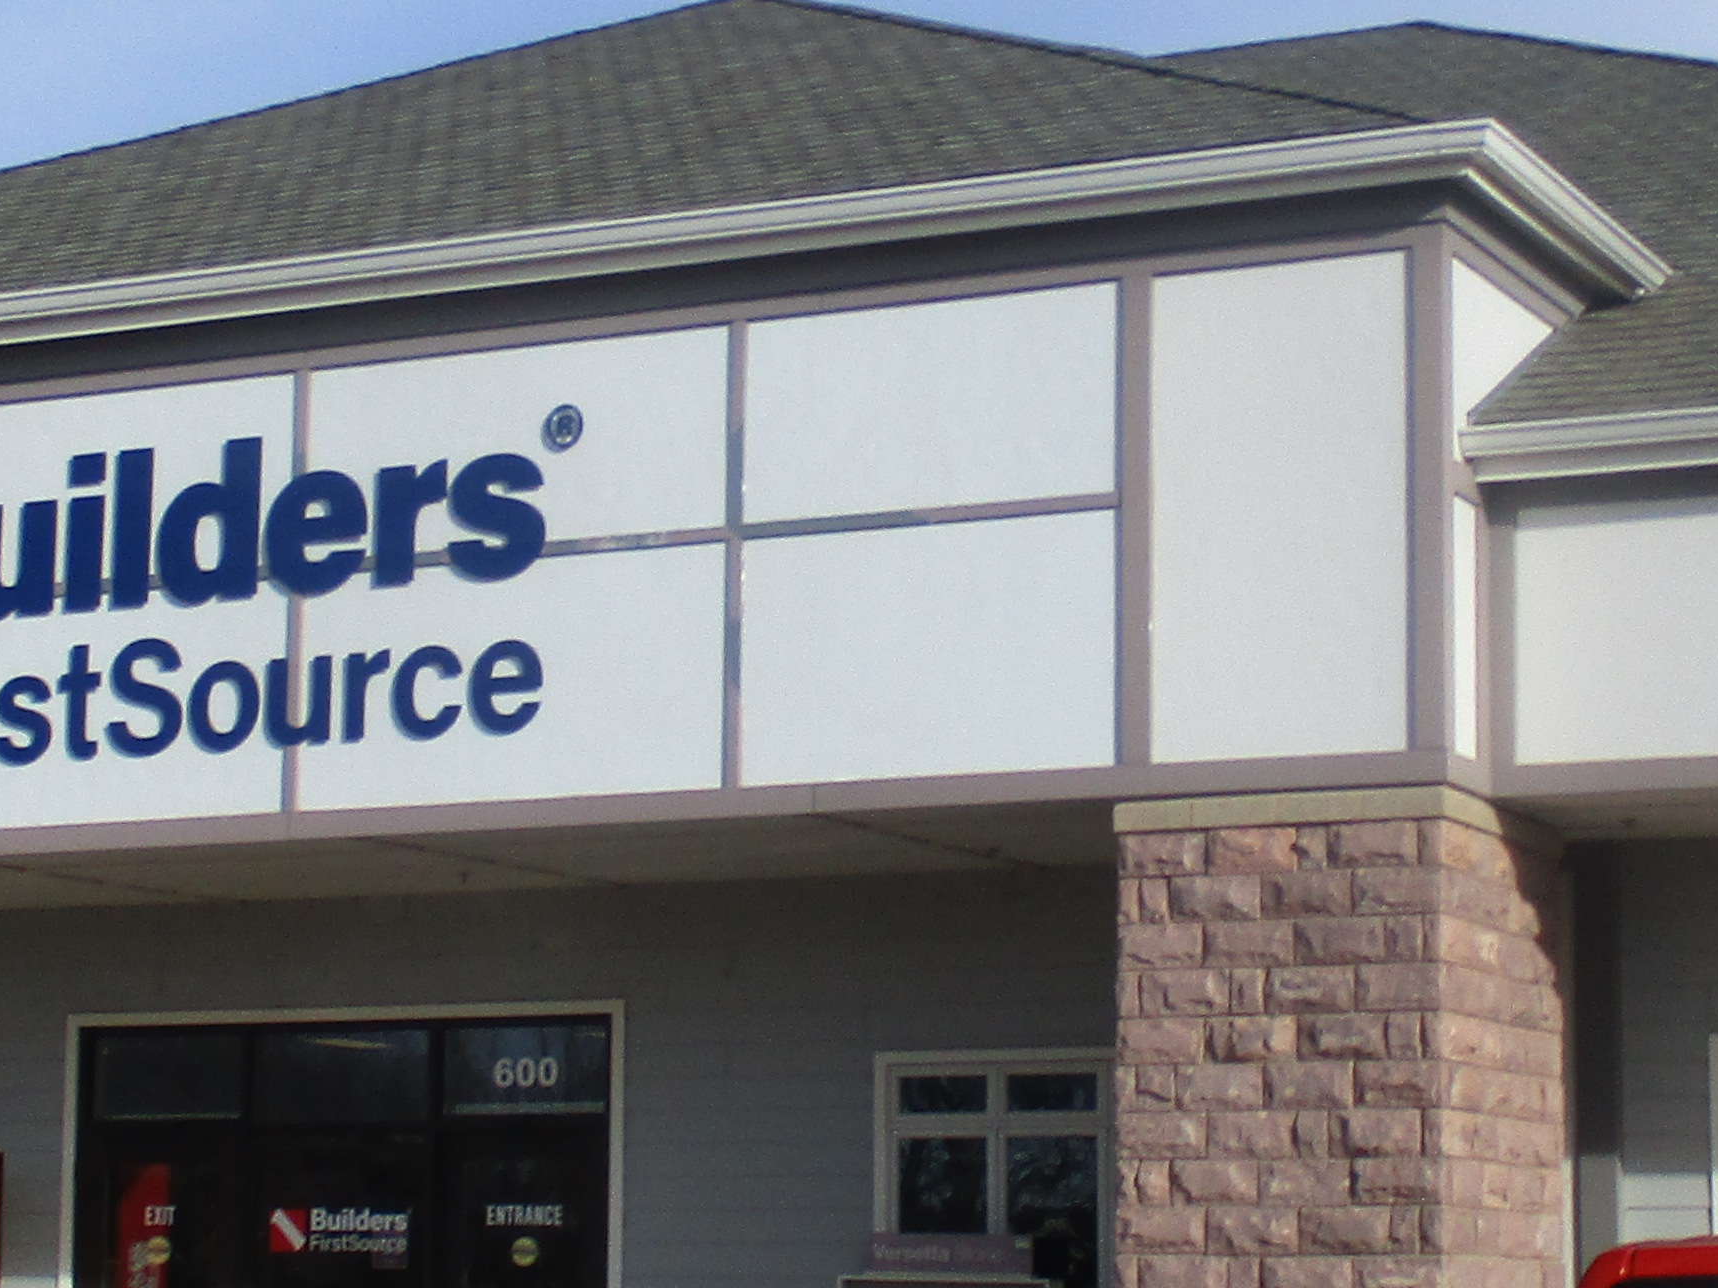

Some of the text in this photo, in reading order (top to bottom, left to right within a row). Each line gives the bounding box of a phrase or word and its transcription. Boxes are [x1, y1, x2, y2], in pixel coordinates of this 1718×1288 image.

[492, 1056, 560, 1089] 600
[143, 1204, 177, 1227] EXIT
[309, 1207, 409, 1232] Builders
[485, 1203, 564, 1227] ENTRANCE
[308, 1233, 408, 1253] FirstSource
